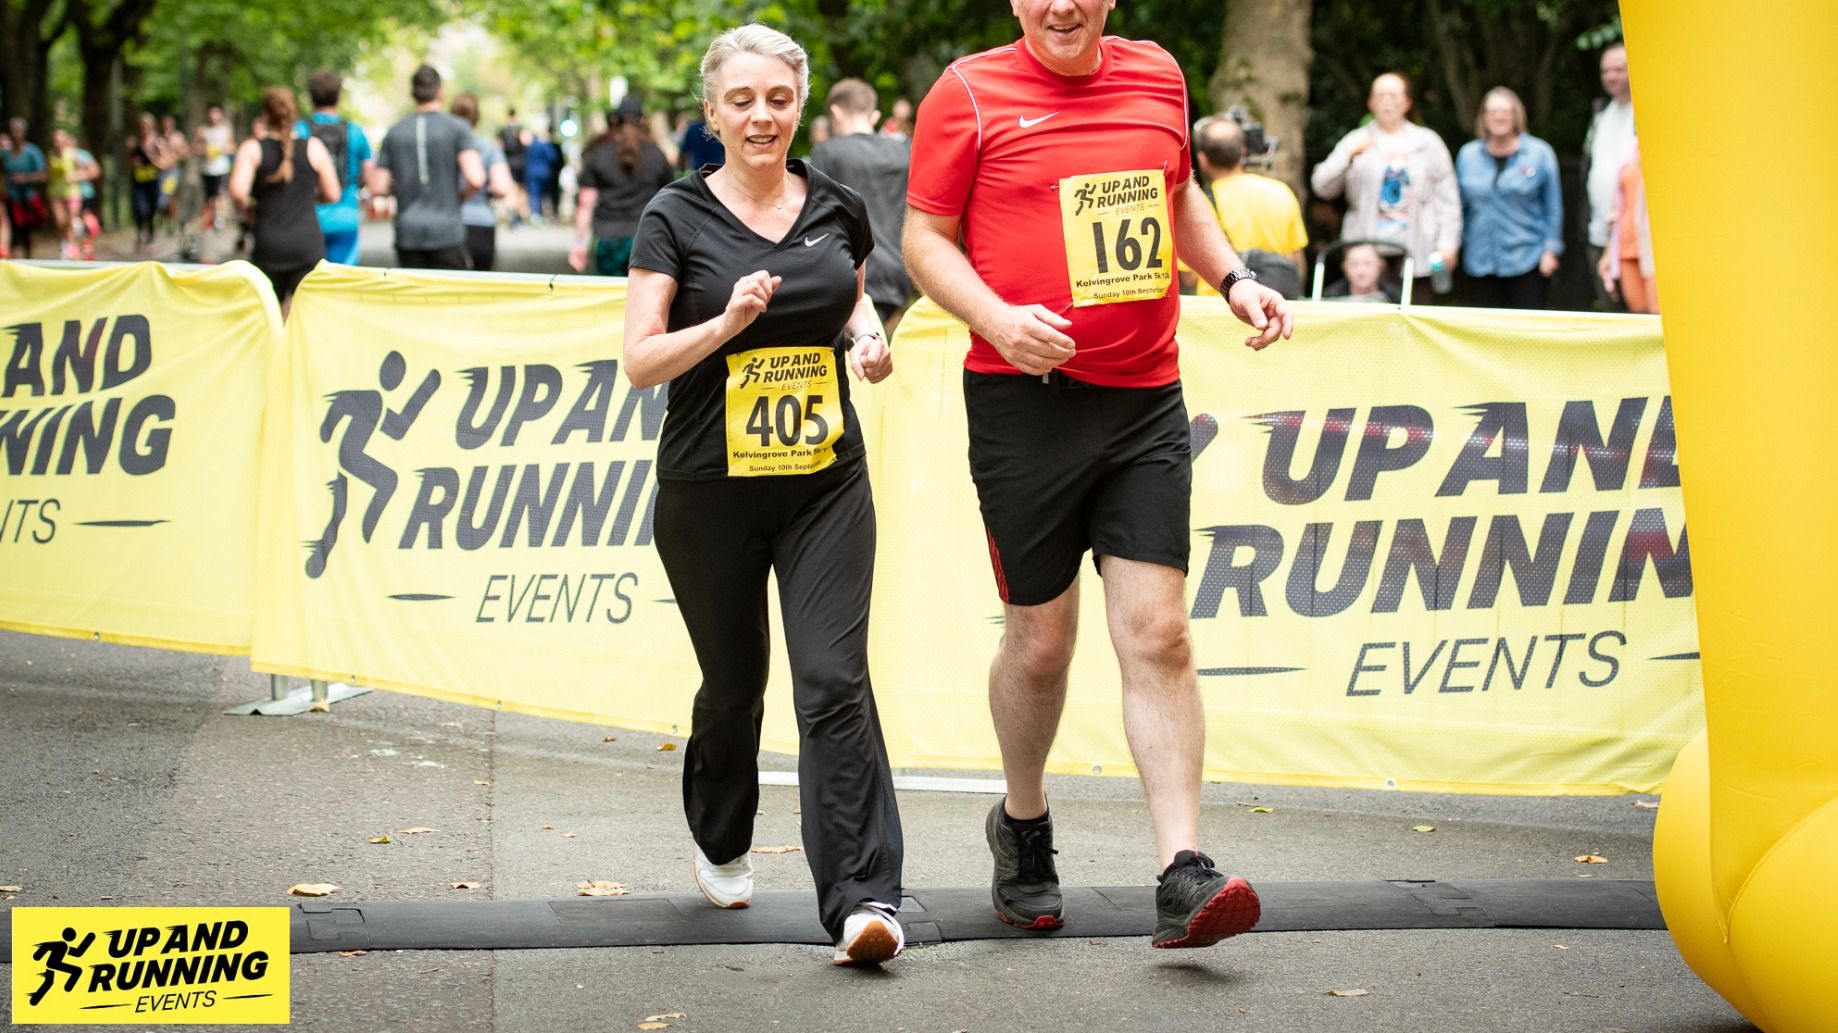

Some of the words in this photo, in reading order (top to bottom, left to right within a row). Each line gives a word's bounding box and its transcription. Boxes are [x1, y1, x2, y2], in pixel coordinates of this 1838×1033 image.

[1097, 187, 1158, 208] RUNNING
[1102, 180, 1121, 194] UP
[1121, 176, 1150, 191] AND
[1115, 204, 1145, 216] EVENTS
[1092, 216, 1162, 273] 162
[1076, 276, 1130, 288] Kelvingrove
[1133, 273, 1152, 281] Park
[0, 314, 152, 397] AND
[769, 355, 790, 369] UP
[793, 352, 821, 366] AND
[763, 365, 827, 383] RUNNING
[781, 380, 812, 391] EVENTS
[455, 364, 563, 450] UP
[551, 359, 670, 445] AN
[746, 395, 828, 447] 405
[0, 394, 176, 476] NING
[733, 450, 788, 460] Kelvingrove
[791, 449, 812, 457] Park
[1241, 404, 1434, 506] UP
[475, 572, 638, 624] EVENTS
[1346, 629, 1627, 697] EVENTS
